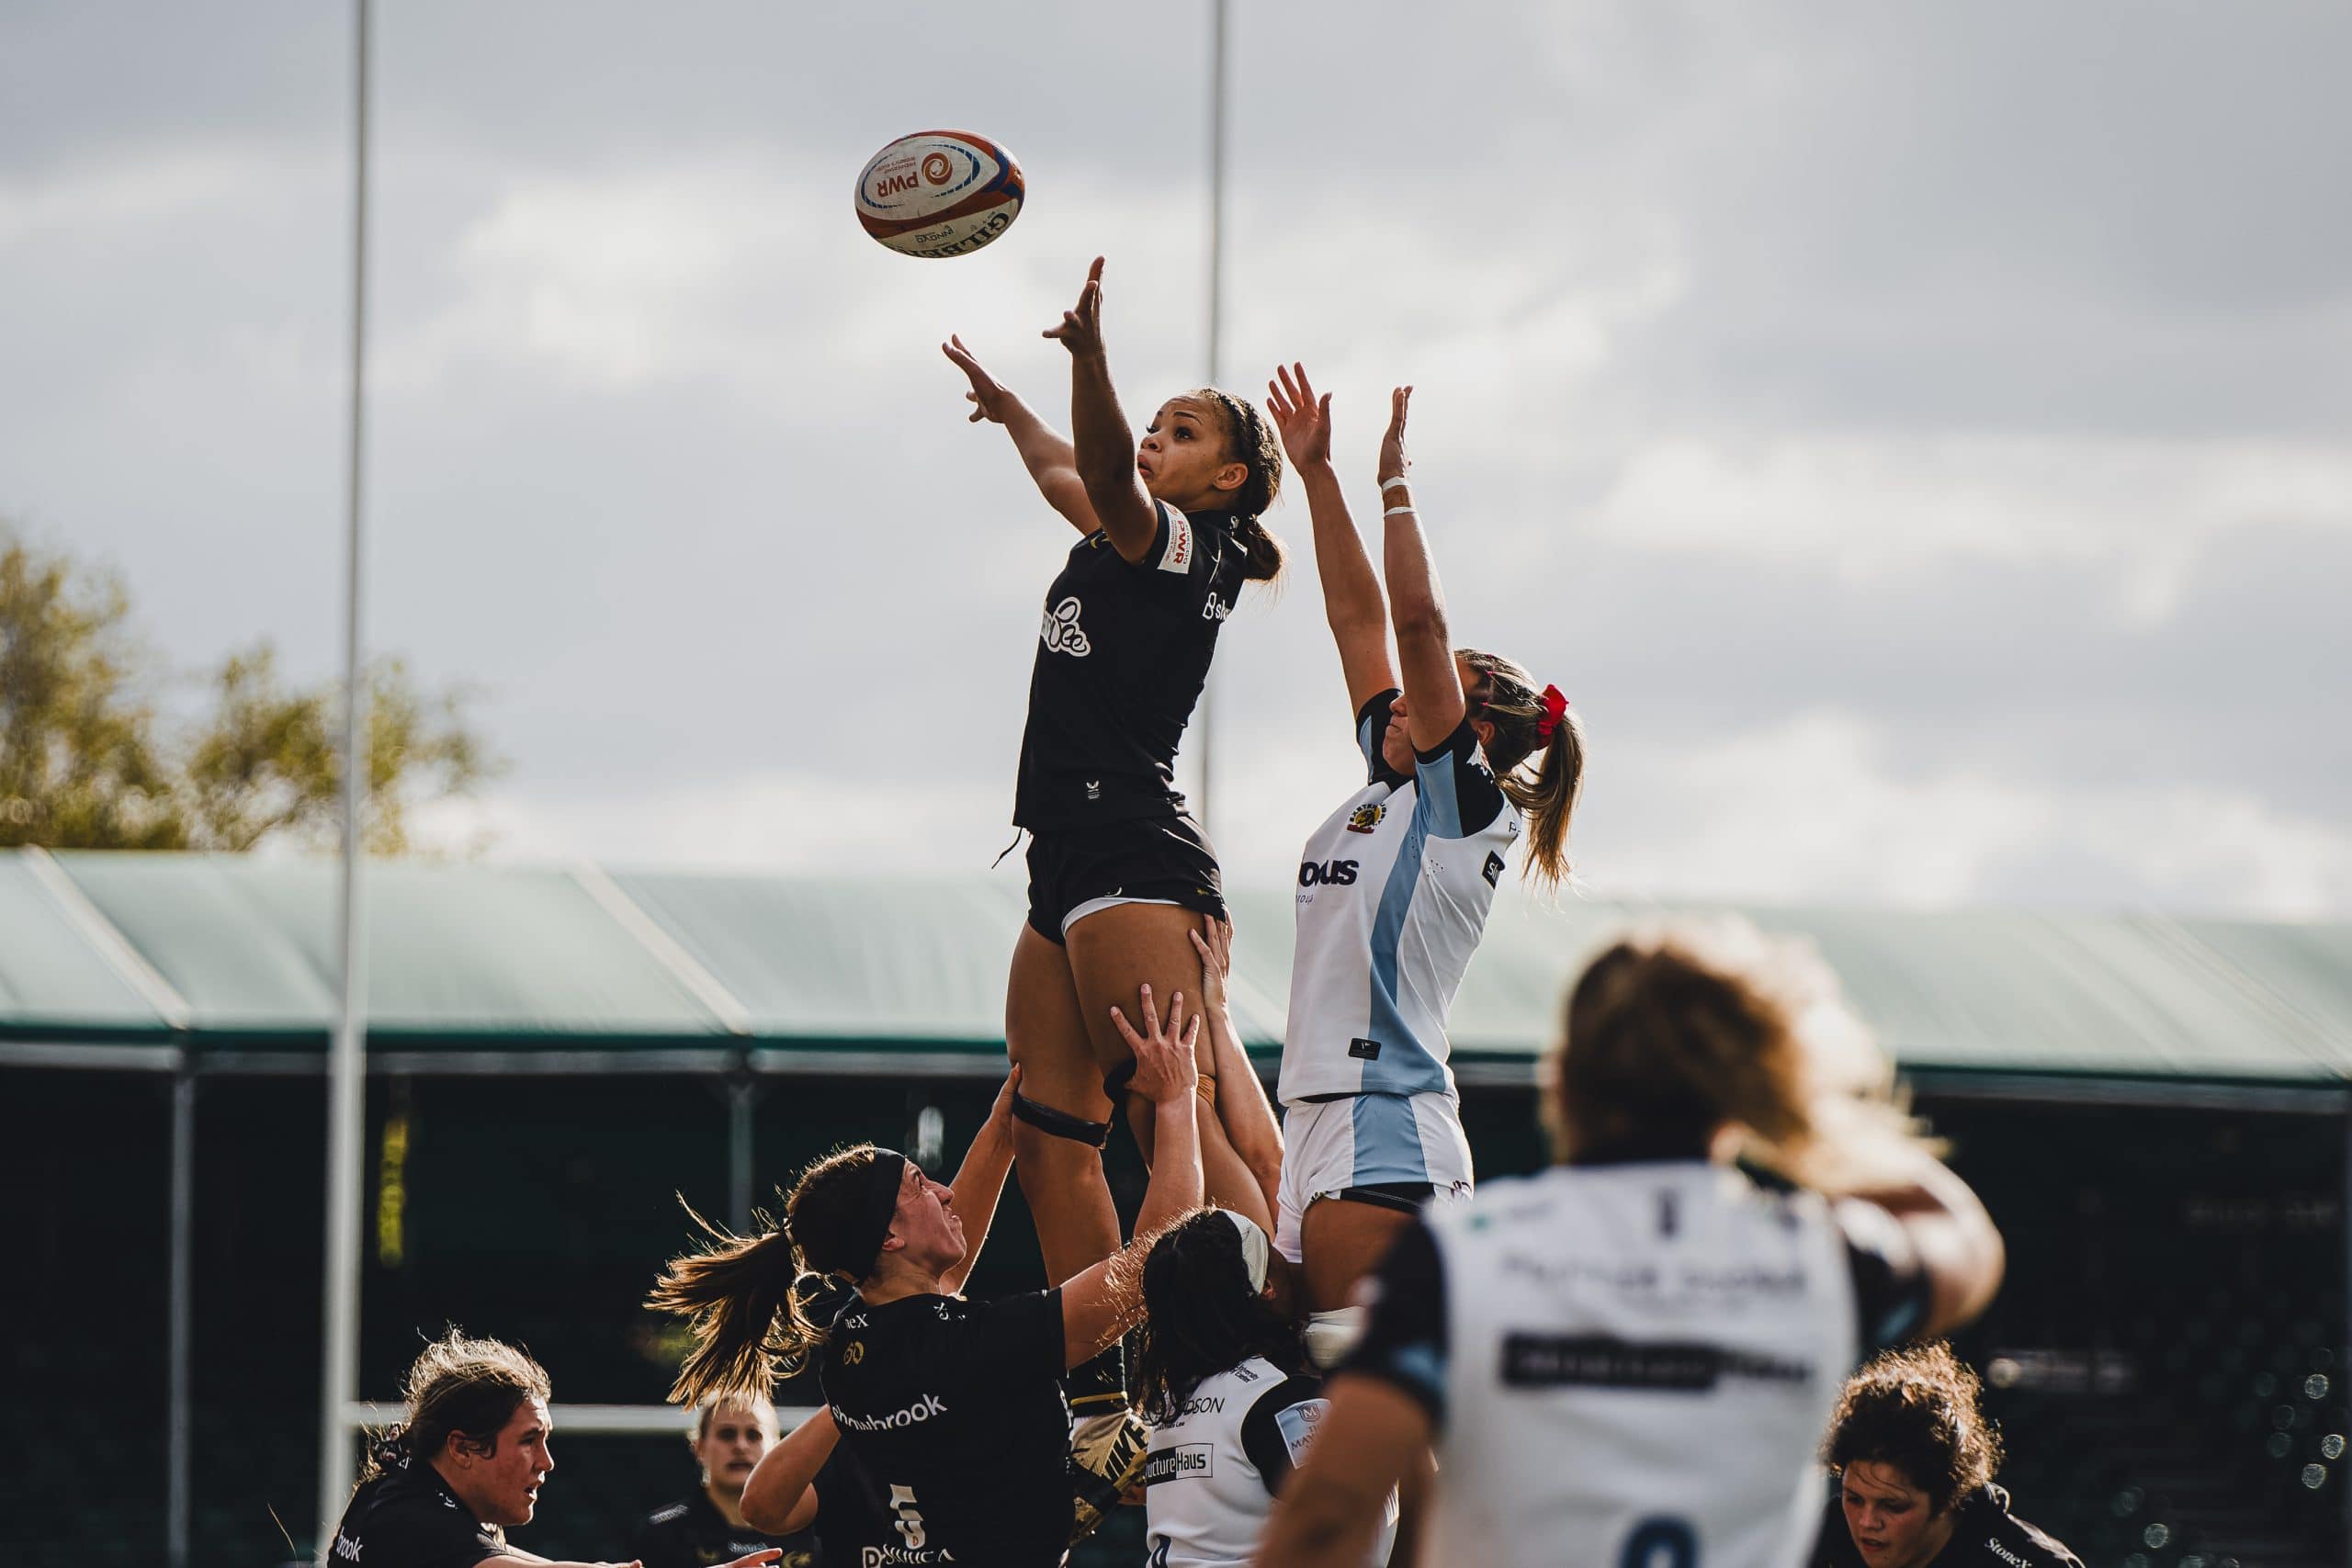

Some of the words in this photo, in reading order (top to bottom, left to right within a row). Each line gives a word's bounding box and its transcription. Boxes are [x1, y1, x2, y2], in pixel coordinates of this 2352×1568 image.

[877, 171, 919, 198] PWR
[1173, 520, 1186, 564] PWR
[1147, 1451, 1206, 1478] uctureHaus
[889, 1483, 927, 1551] 5
